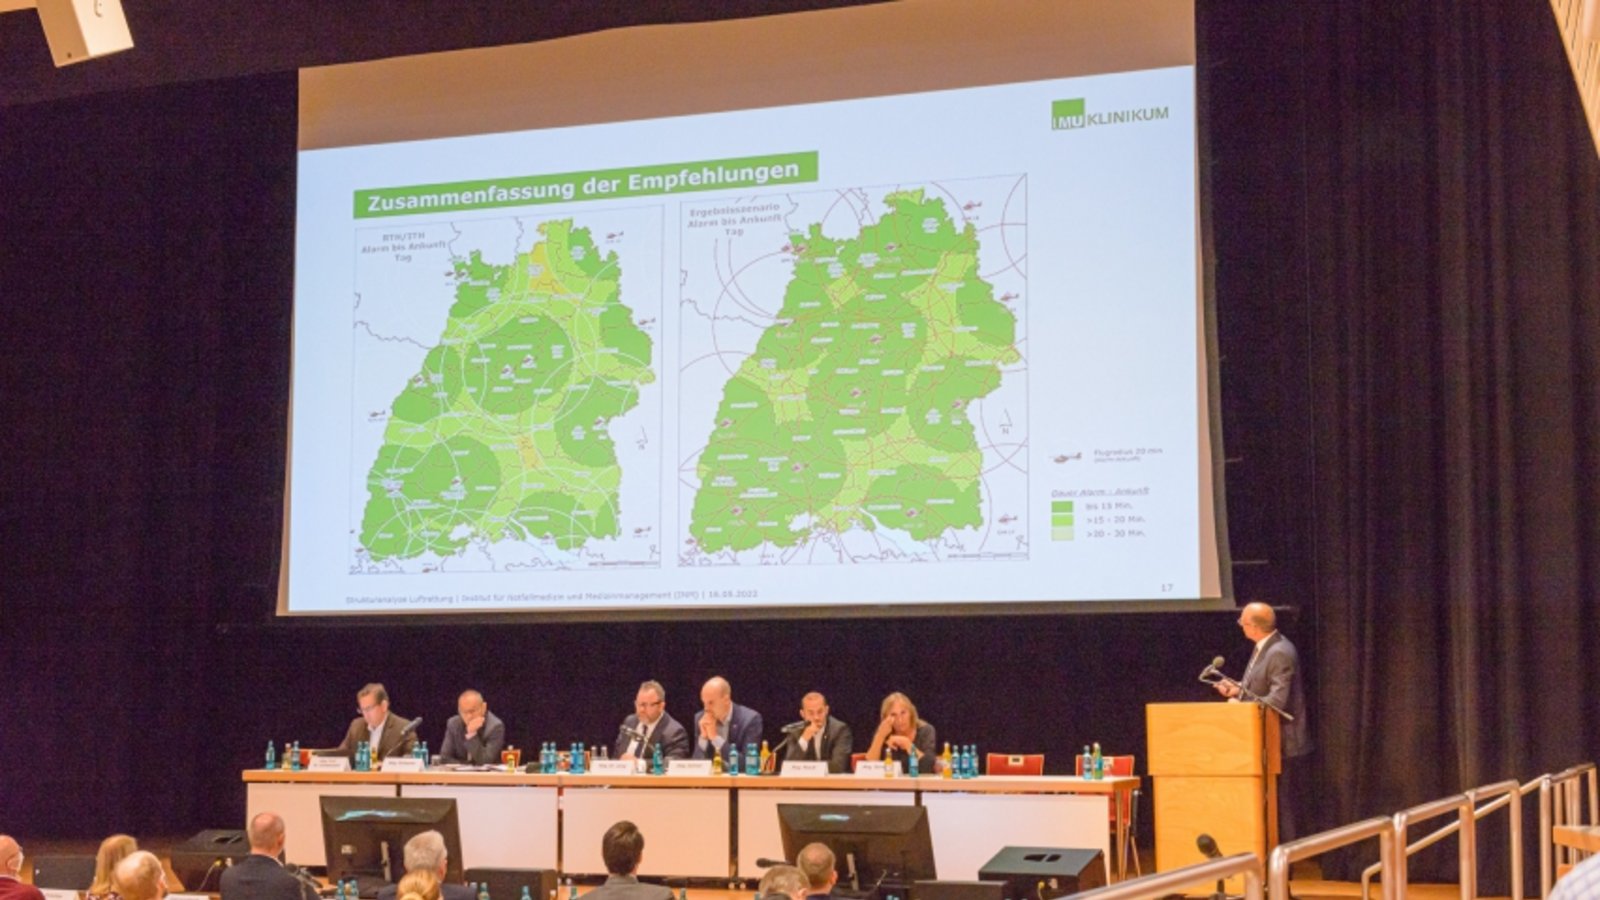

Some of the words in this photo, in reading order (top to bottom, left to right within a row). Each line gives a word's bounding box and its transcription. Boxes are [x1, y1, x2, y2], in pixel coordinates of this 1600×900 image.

[1087, 106, 1169, 127] KLINIKUM
[367, 183, 576, 213] Zusammenfassung
[582, 176, 621, 195] der
[628, 162, 800, 191] Empfehlungen
[687, 219, 719, 228] Alarm
[721, 216, 737, 226] bis
[740, 213, 782, 225] Ankunft
[725, 228, 745, 237] Tag
[361, 245, 390, 254] Alarm
[391, 243, 406, 252] bis
[408, 240, 446, 251] Ankunft
[395, 253, 412, 263] Tag
[1114, 515, 1126, 524] 20
[1114, 529, 1126, 538] 30
[1161, 583, 1174, 593] 17
